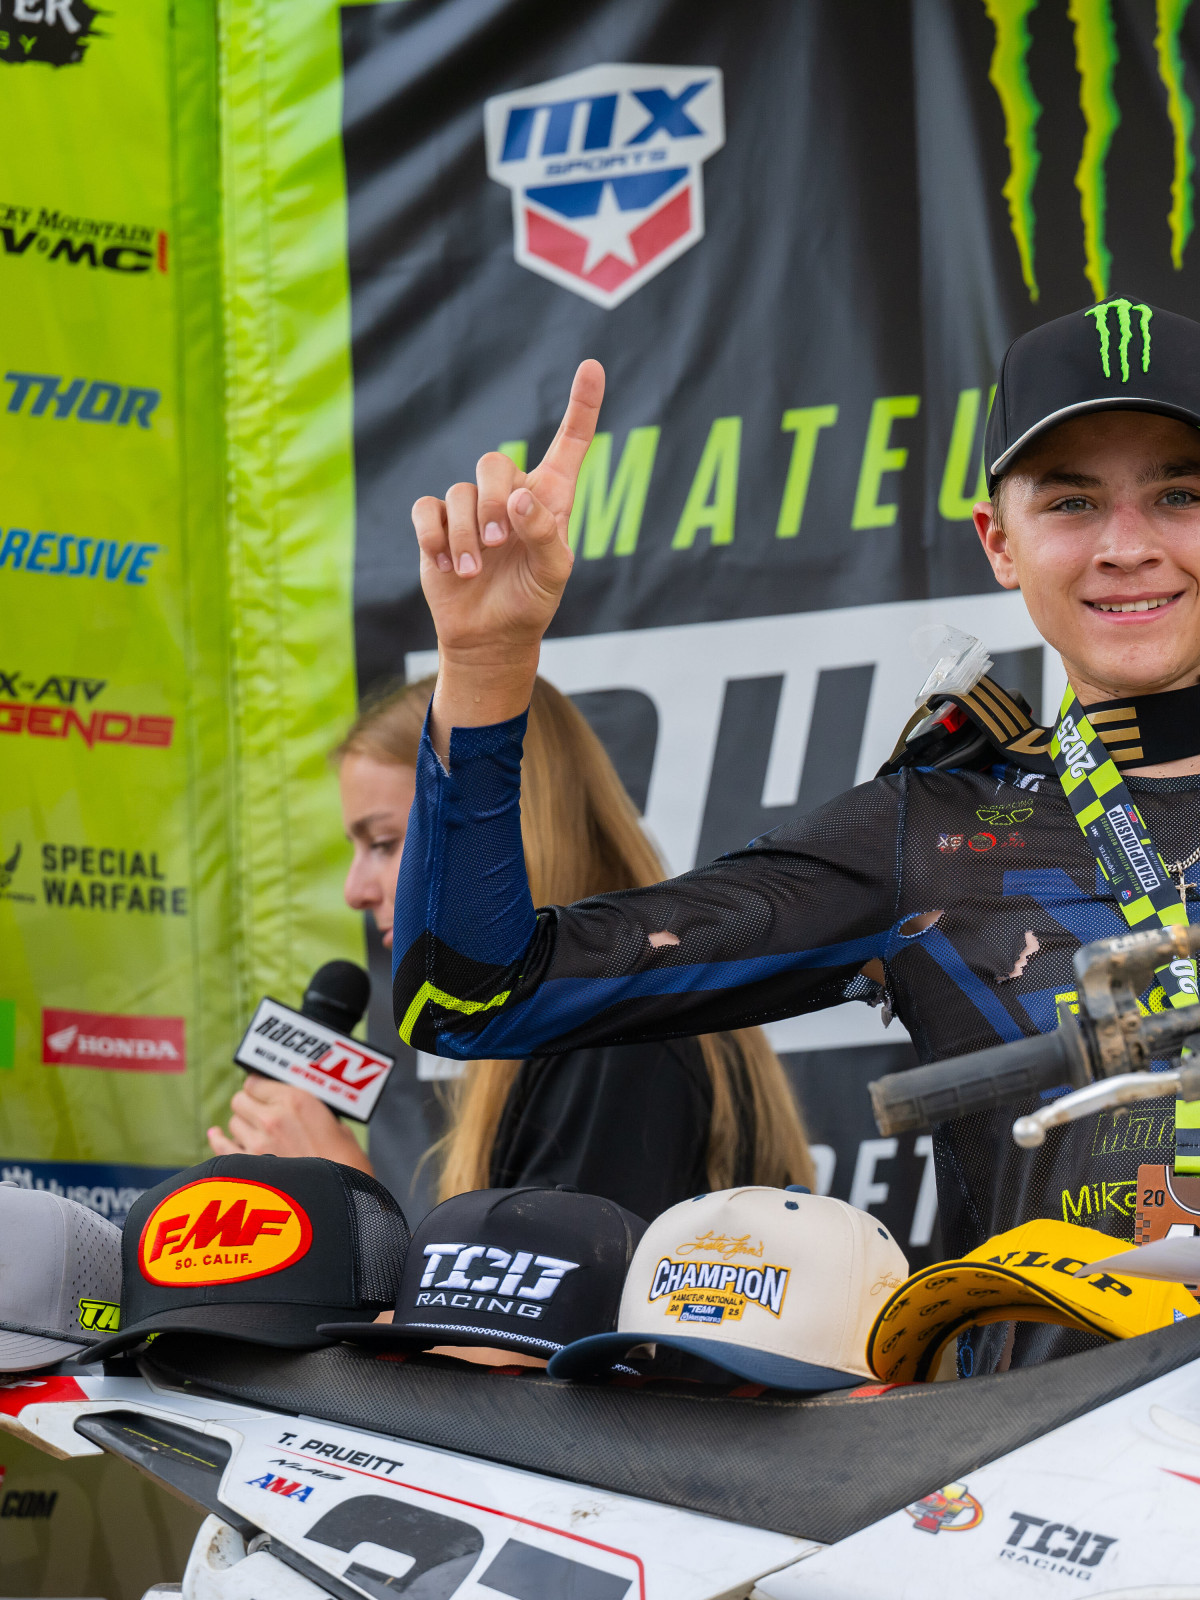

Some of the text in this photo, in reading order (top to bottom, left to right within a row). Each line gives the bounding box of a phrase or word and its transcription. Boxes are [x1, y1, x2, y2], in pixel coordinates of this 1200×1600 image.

[500, 78, 715, 166] MX
[545, 147, 669, 178] SPORTS
[2, 371, 161, 429] THOR
[0, 528, 161, 587] RESSIVE
[1056, 714, 1098, 780] 2025
[41, 842, 167, 881] SPECIAL
[1107, 807, 1159, 891] CHAMPIONSHIP
[42, 876, 188, 917] WARFARE
[77, 1033, 180, 1062] HONDA
[1143, 1189, 1165, 1208] 20
[148, 1199, 292, 1264] FMF
[174, 1252, 253, 1271] SO. CALIF.
[650, 1258, 789, 1315] CHAMPION
[677, 1294, 738, 1306] AMATEUR NATIONAL
[414, 1291, 543, 1321] RACING
[669, 1304, 680, 1312] 20
[688, 1304, 716, 1315] TEAM
[728, 1308, 740, 1316] 25
[277, 1431, 404, 1475] T. PRUEITT
[246, 1472, 315, 1503] AMA
[999, 1548, 1092, 1582] RACING
